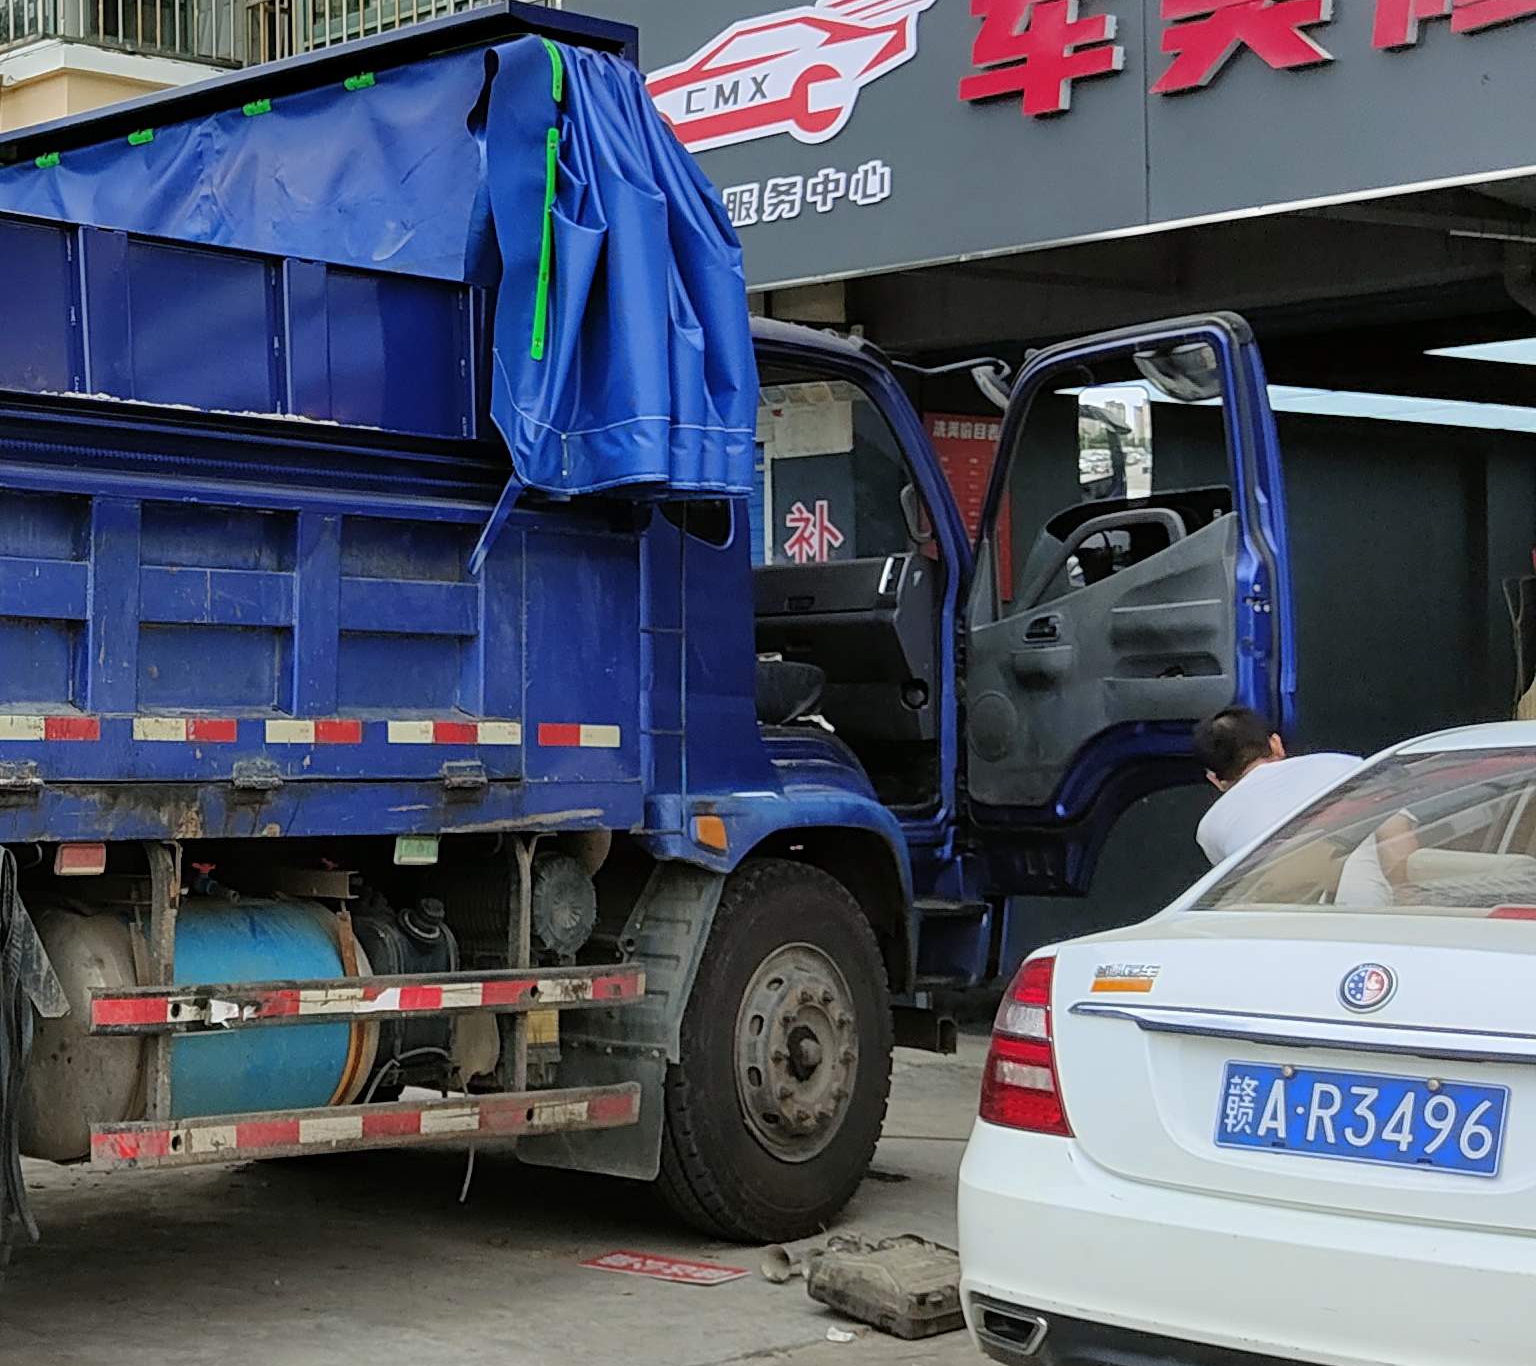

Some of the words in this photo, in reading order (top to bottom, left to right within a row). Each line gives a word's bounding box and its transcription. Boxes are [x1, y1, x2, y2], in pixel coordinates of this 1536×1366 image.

[684, 73, 771, 116] CMX
[722, 159, 892, 228] 服务中心
[784, 500, 845, 565] 补
